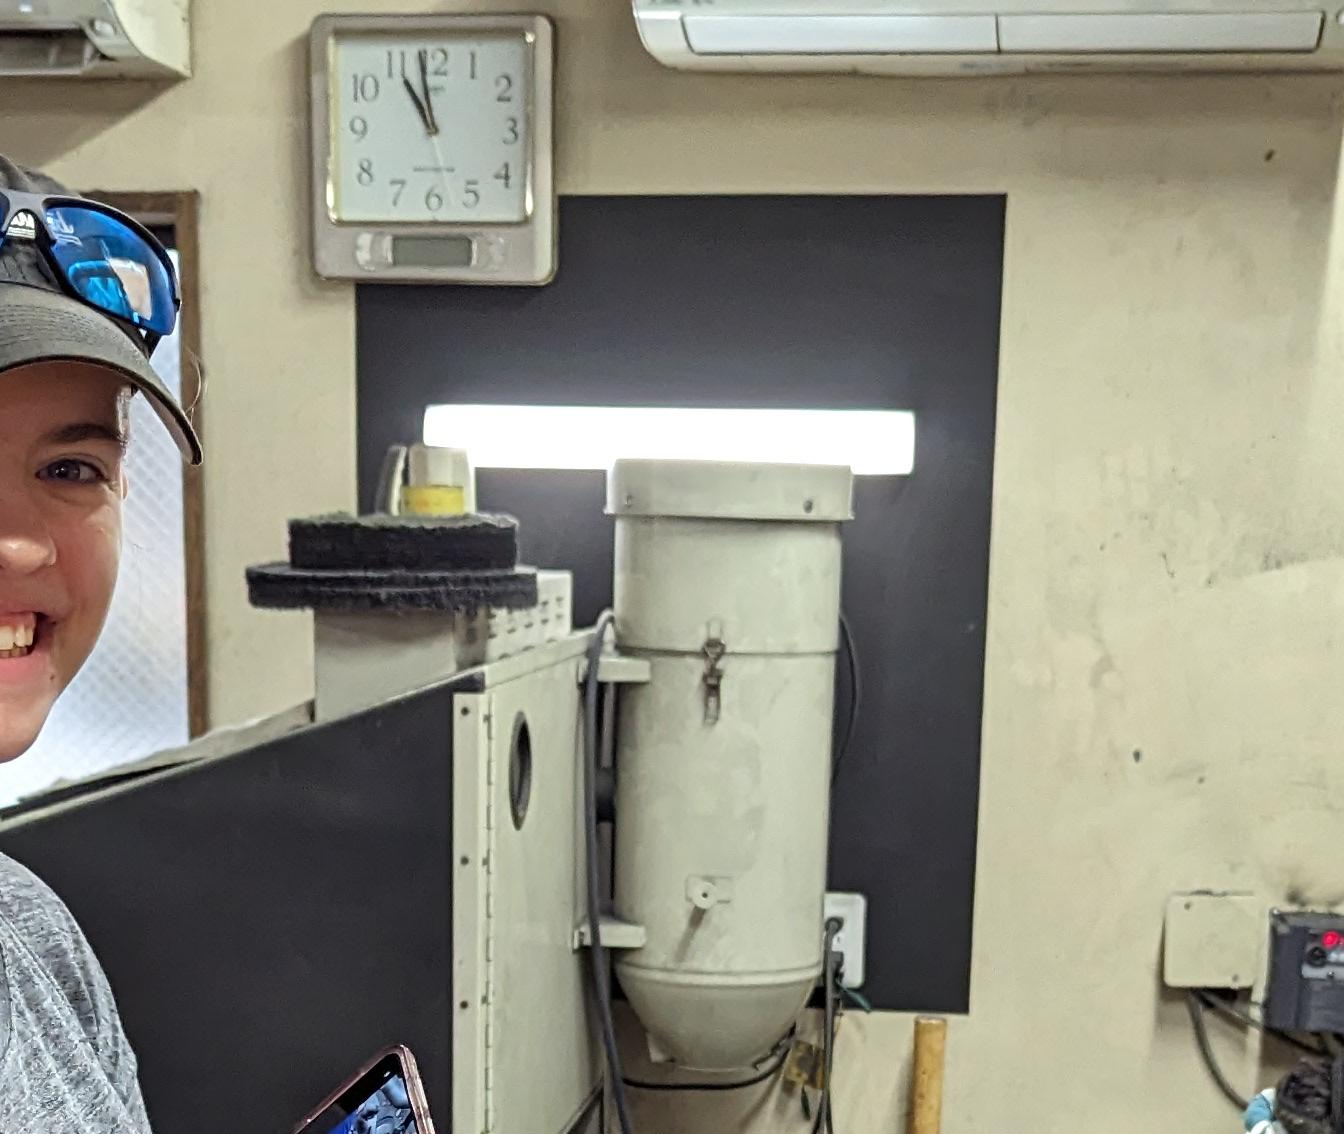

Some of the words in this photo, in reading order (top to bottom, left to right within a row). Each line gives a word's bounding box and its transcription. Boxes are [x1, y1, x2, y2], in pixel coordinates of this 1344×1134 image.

[387, 50, 406, 78] 11
[423, 48, 448, 76] 12
[470, 51, 477, 79] 1
[352, 74, 379, 103] 10
[495, 74, 512, 103] 2
[349, 117, 368, 143] 9
[502, 118, 519, 145] 3
[356, 158, 374, 187] 8
[494, 162, 511, 188] 4
[389, 179, 407, 207] 7
[425, 184, 443, 212] 6
[463, 180, 480, 209] 5
